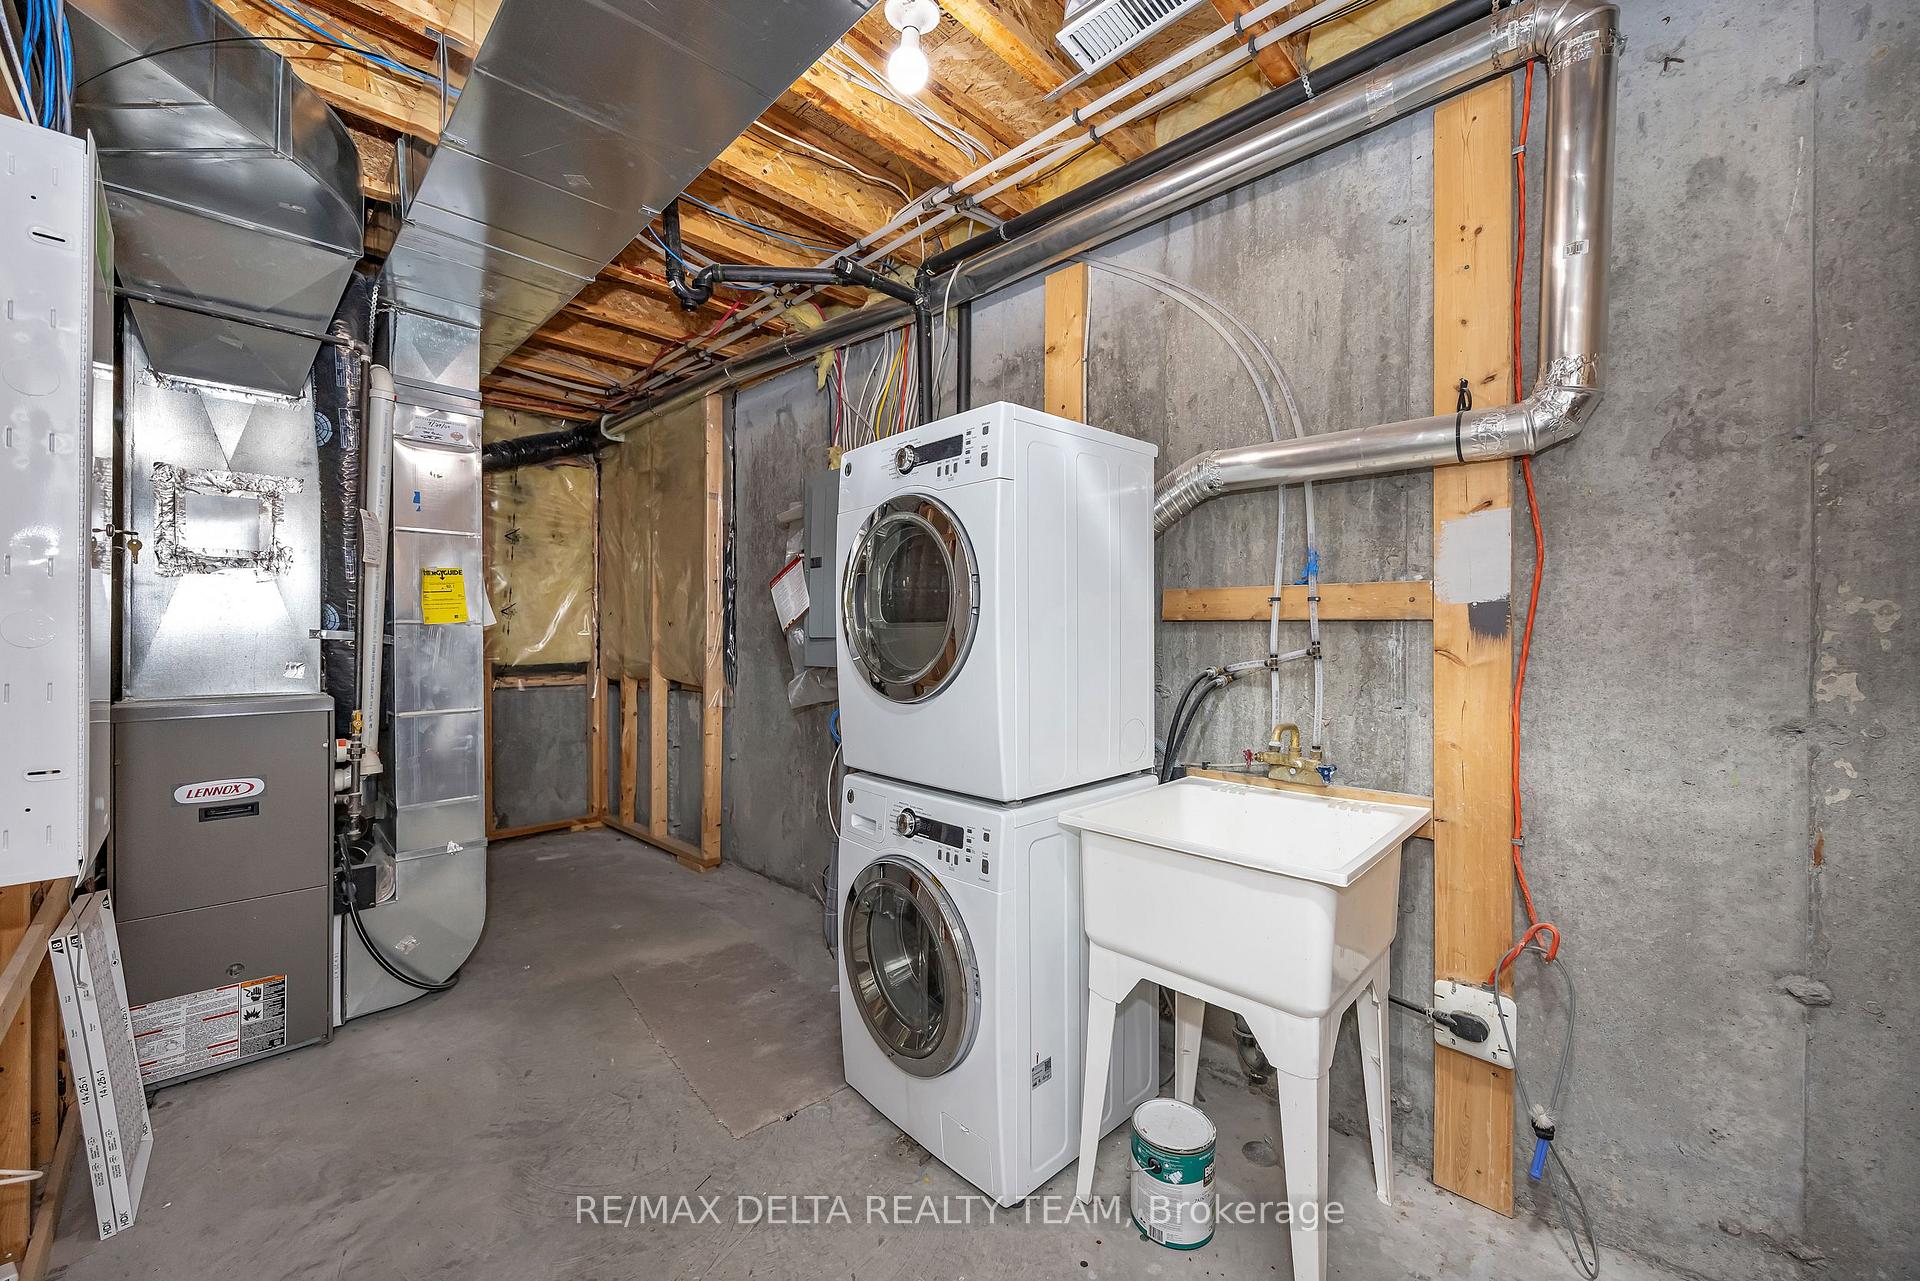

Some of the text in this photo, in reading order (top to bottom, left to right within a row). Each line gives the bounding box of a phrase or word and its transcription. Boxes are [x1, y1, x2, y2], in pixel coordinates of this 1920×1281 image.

[186, 784, 241, 799] LENNOX
[102, 1218, 112, 1236] HDX
[119, 1210, 130, 1228] HDX
